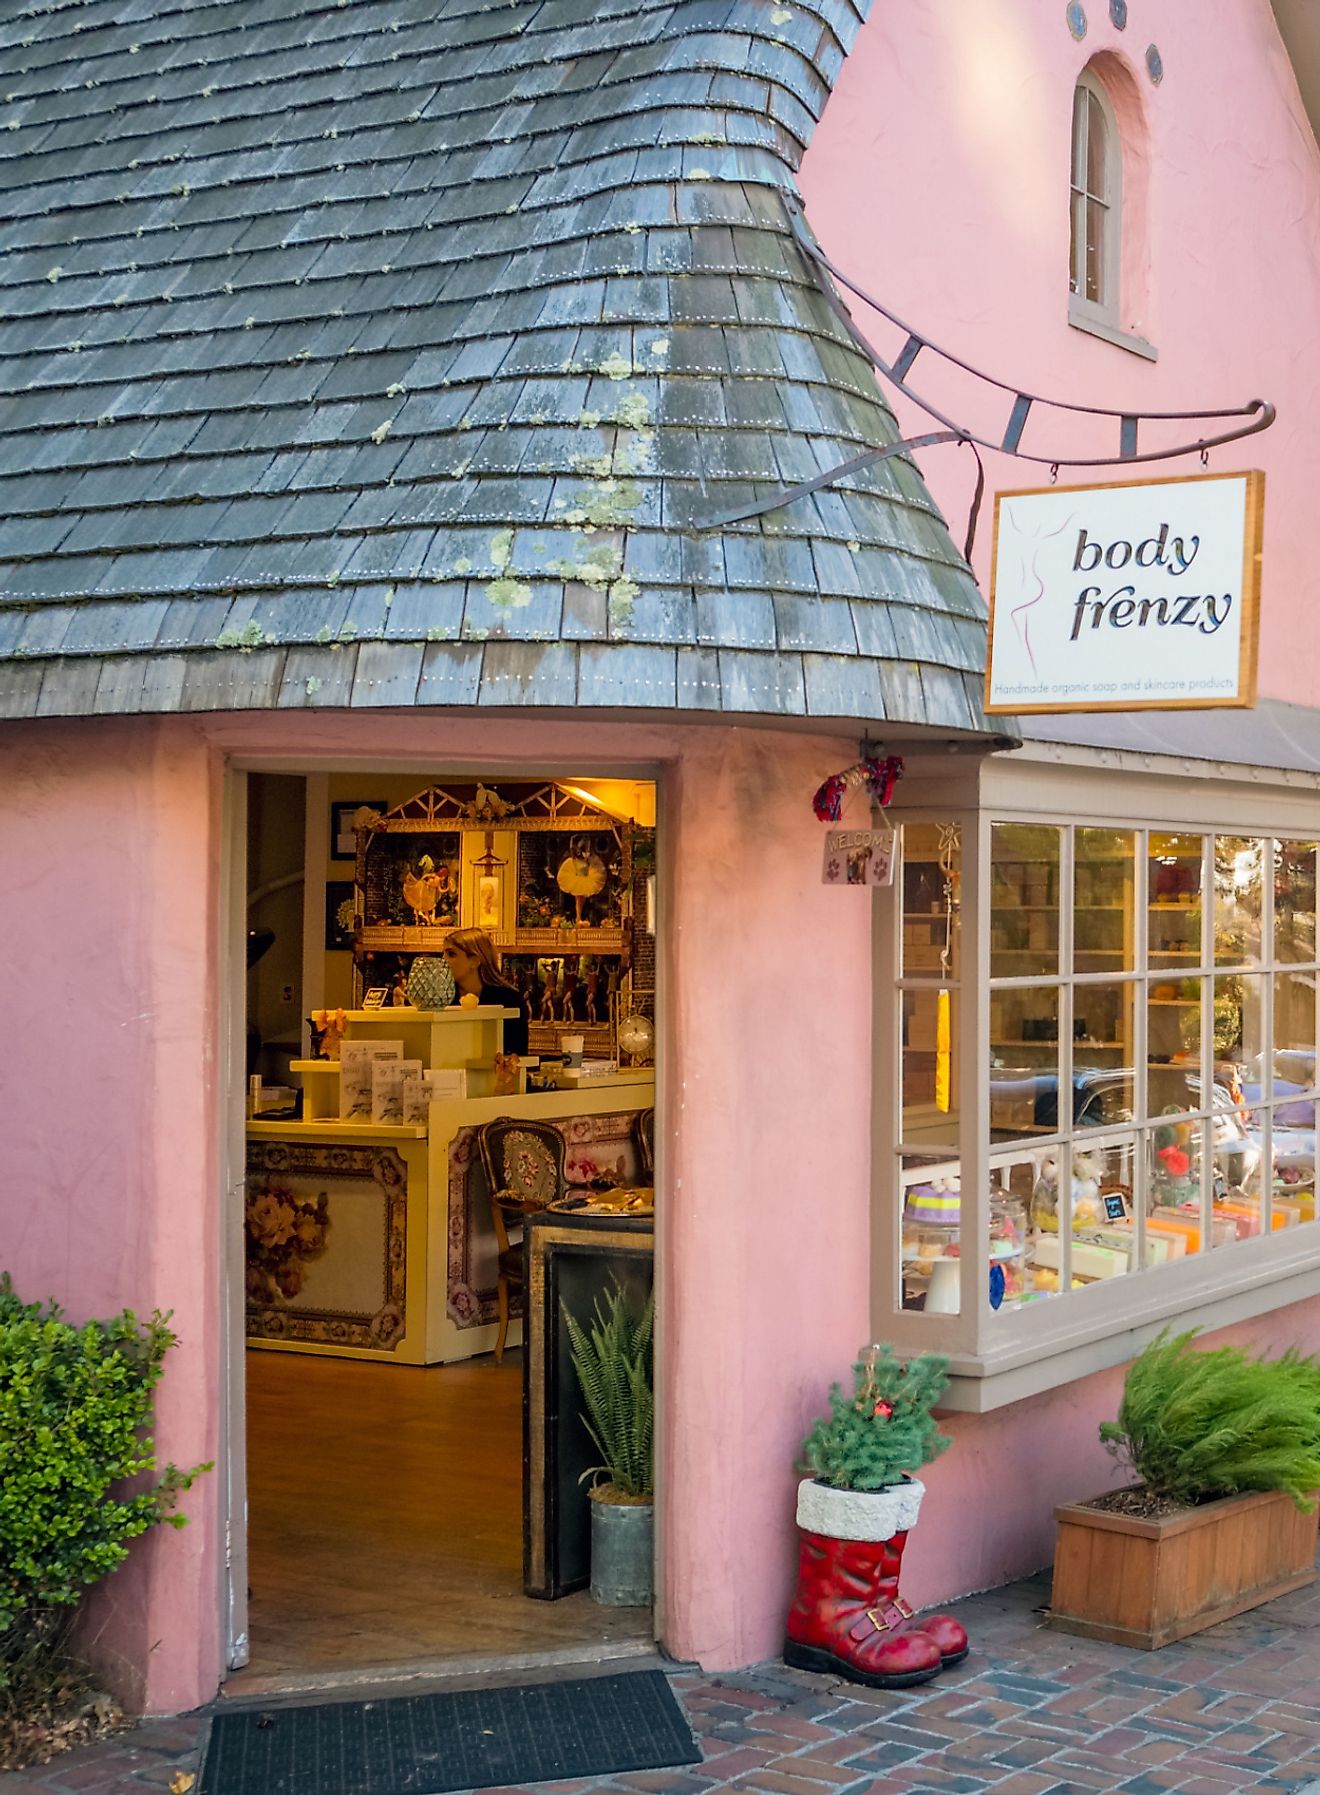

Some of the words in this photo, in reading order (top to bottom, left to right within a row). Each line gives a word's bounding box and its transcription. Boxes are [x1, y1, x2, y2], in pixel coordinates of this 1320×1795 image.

[1073, 523, 1200, 576] body
[1069, 585, 1233, 641] frenzy
[994, 684, 1049, 695] Handmade
[1051, 684, 1089, 696] organic
[1092, 683, 1117, 694] soap
[1120, 680, 1141, 691] and
[1144, 679, 1185, 690] skincare
[1188, 677, 1234, 691] products
